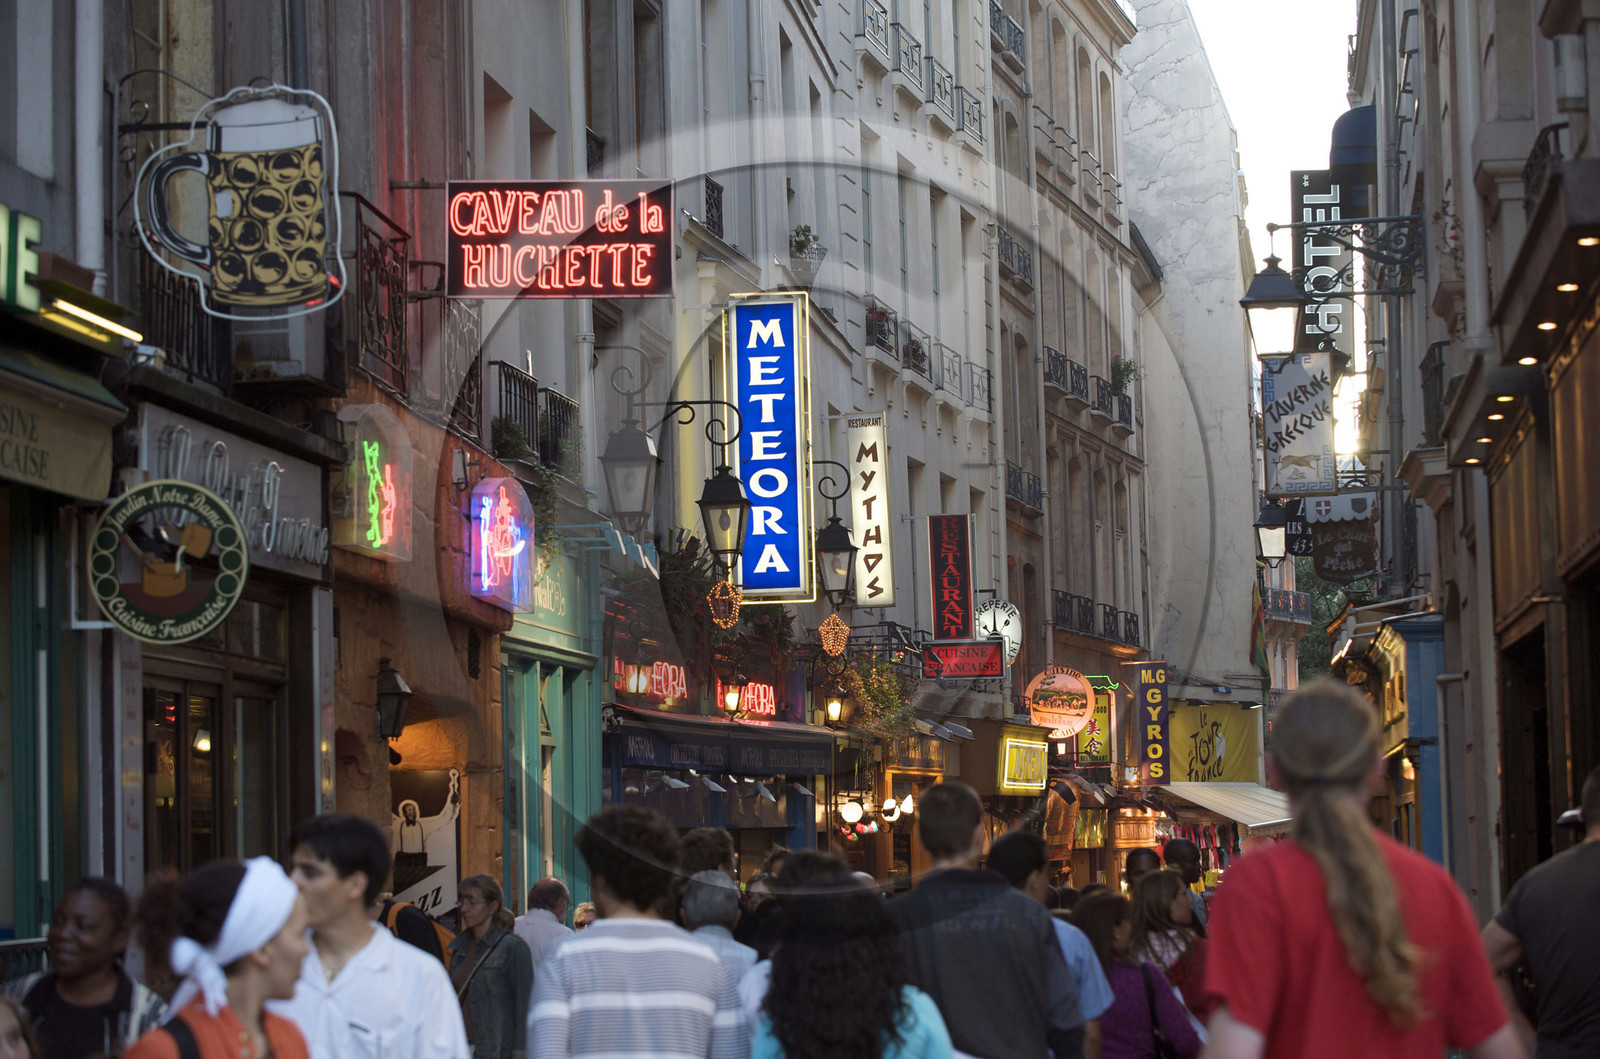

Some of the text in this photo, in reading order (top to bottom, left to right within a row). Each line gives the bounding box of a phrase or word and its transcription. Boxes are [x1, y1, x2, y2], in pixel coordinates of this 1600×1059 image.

[449, 188, 664, 236] CAVEAU de la
[461, 243, 655, 290] HUCHETTE
[1303, 184, 1342, 335] HOTEL
[1265, 369, 1331, 424] TAVERNE
[746, 318, 790, 574] METEORA
[848, 417, 882, 429] RESTAURANT
[1266, 400, 1332, 453] GRECQUE
[106, 485, 224, 533] Jardin Notre Dame
[855, 441, 884, 599] MYTHOS
[1286, 521, 1302, 535] LES
[941, 517, 964, 637] RESTAURANT
[108, 595, 228, 639] Cuisine Française
[937, 647, 988, 658] CUISINE
[1141, 669, 1166, 684] M.G
[1085, 718, 1103, 754] 美食
[1146, 687, 1164, 778] GYROS
